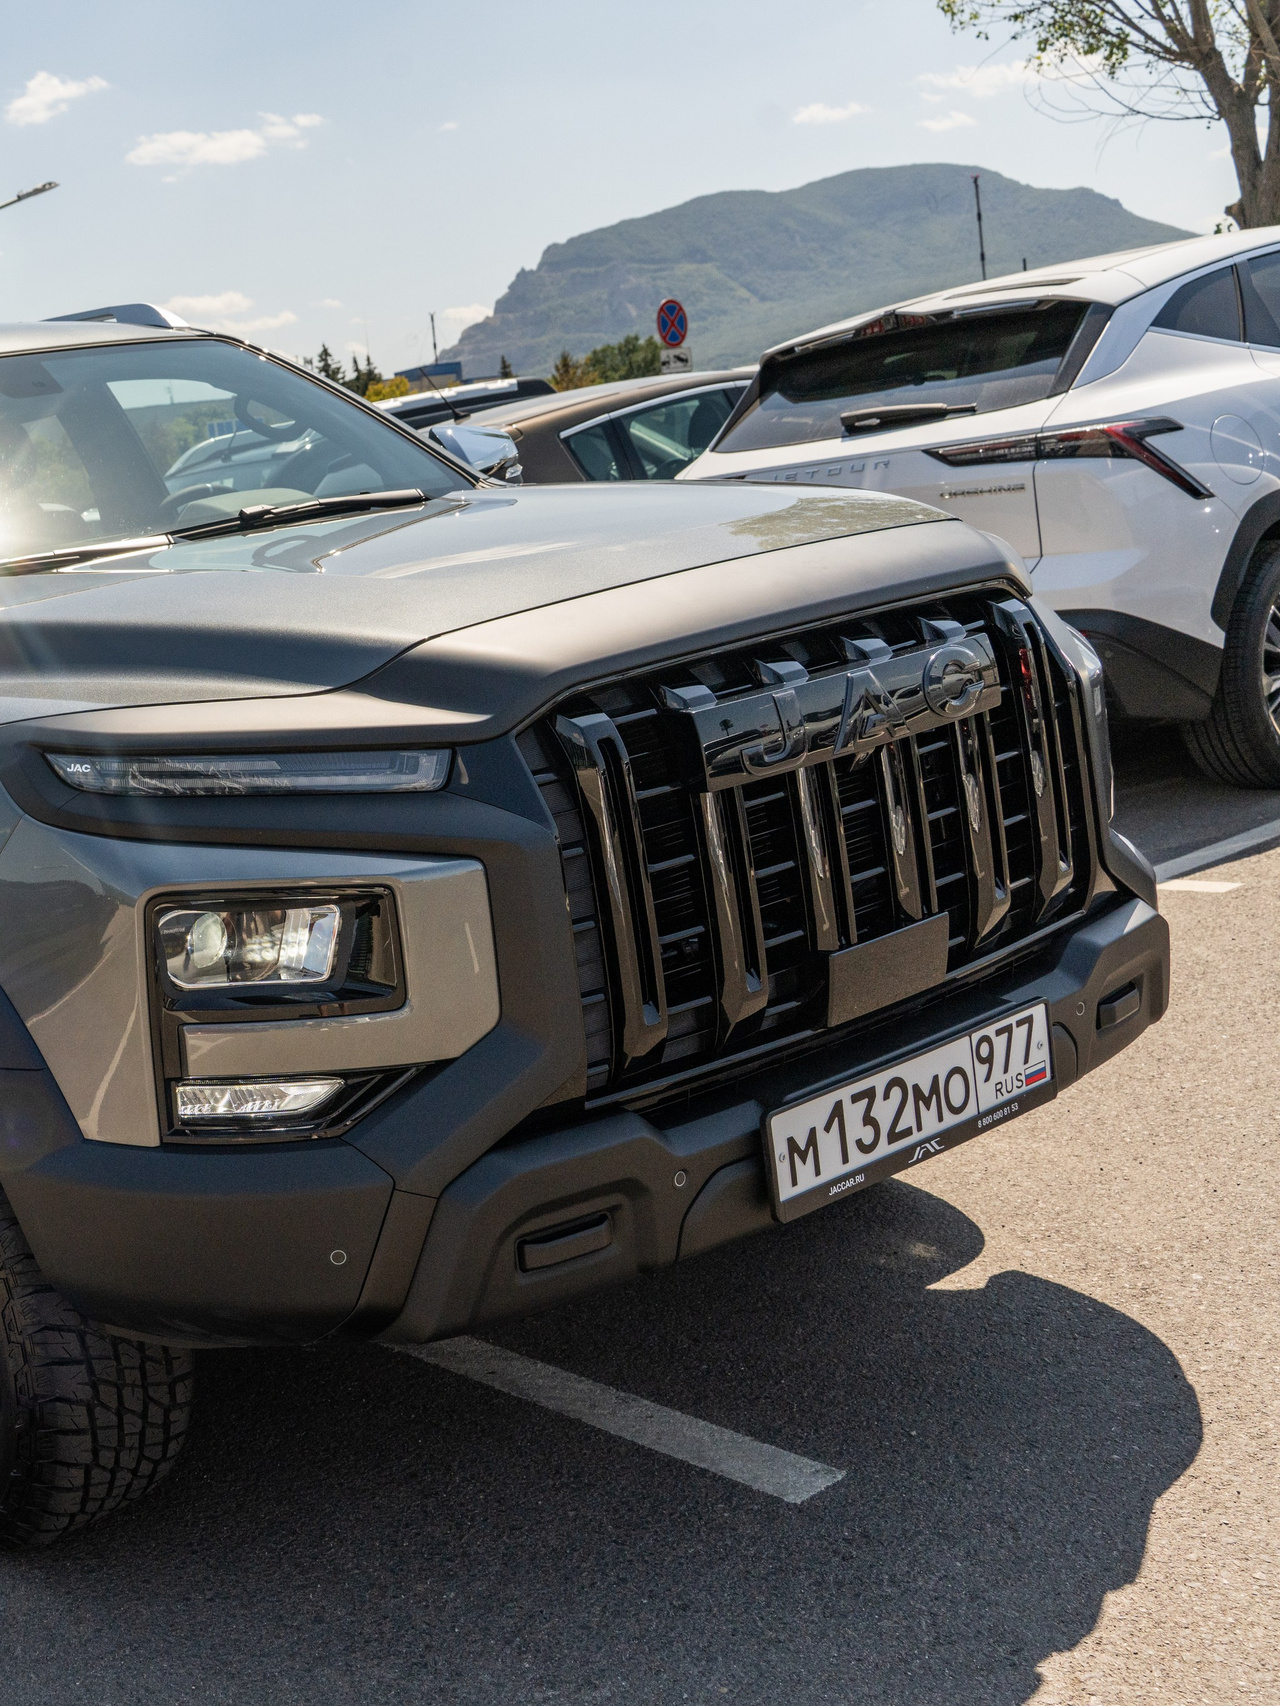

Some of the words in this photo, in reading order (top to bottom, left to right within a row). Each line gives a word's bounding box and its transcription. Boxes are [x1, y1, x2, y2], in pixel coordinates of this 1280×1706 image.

[741, 645, 985, 776] JAC
[67, 763, 91, 773] JAC
[975, 1014, 1034, 1083] 977
[994, 1073, 1024, 1099] RUS
[829, 1173, 865, 1196] JACCAR.RU
